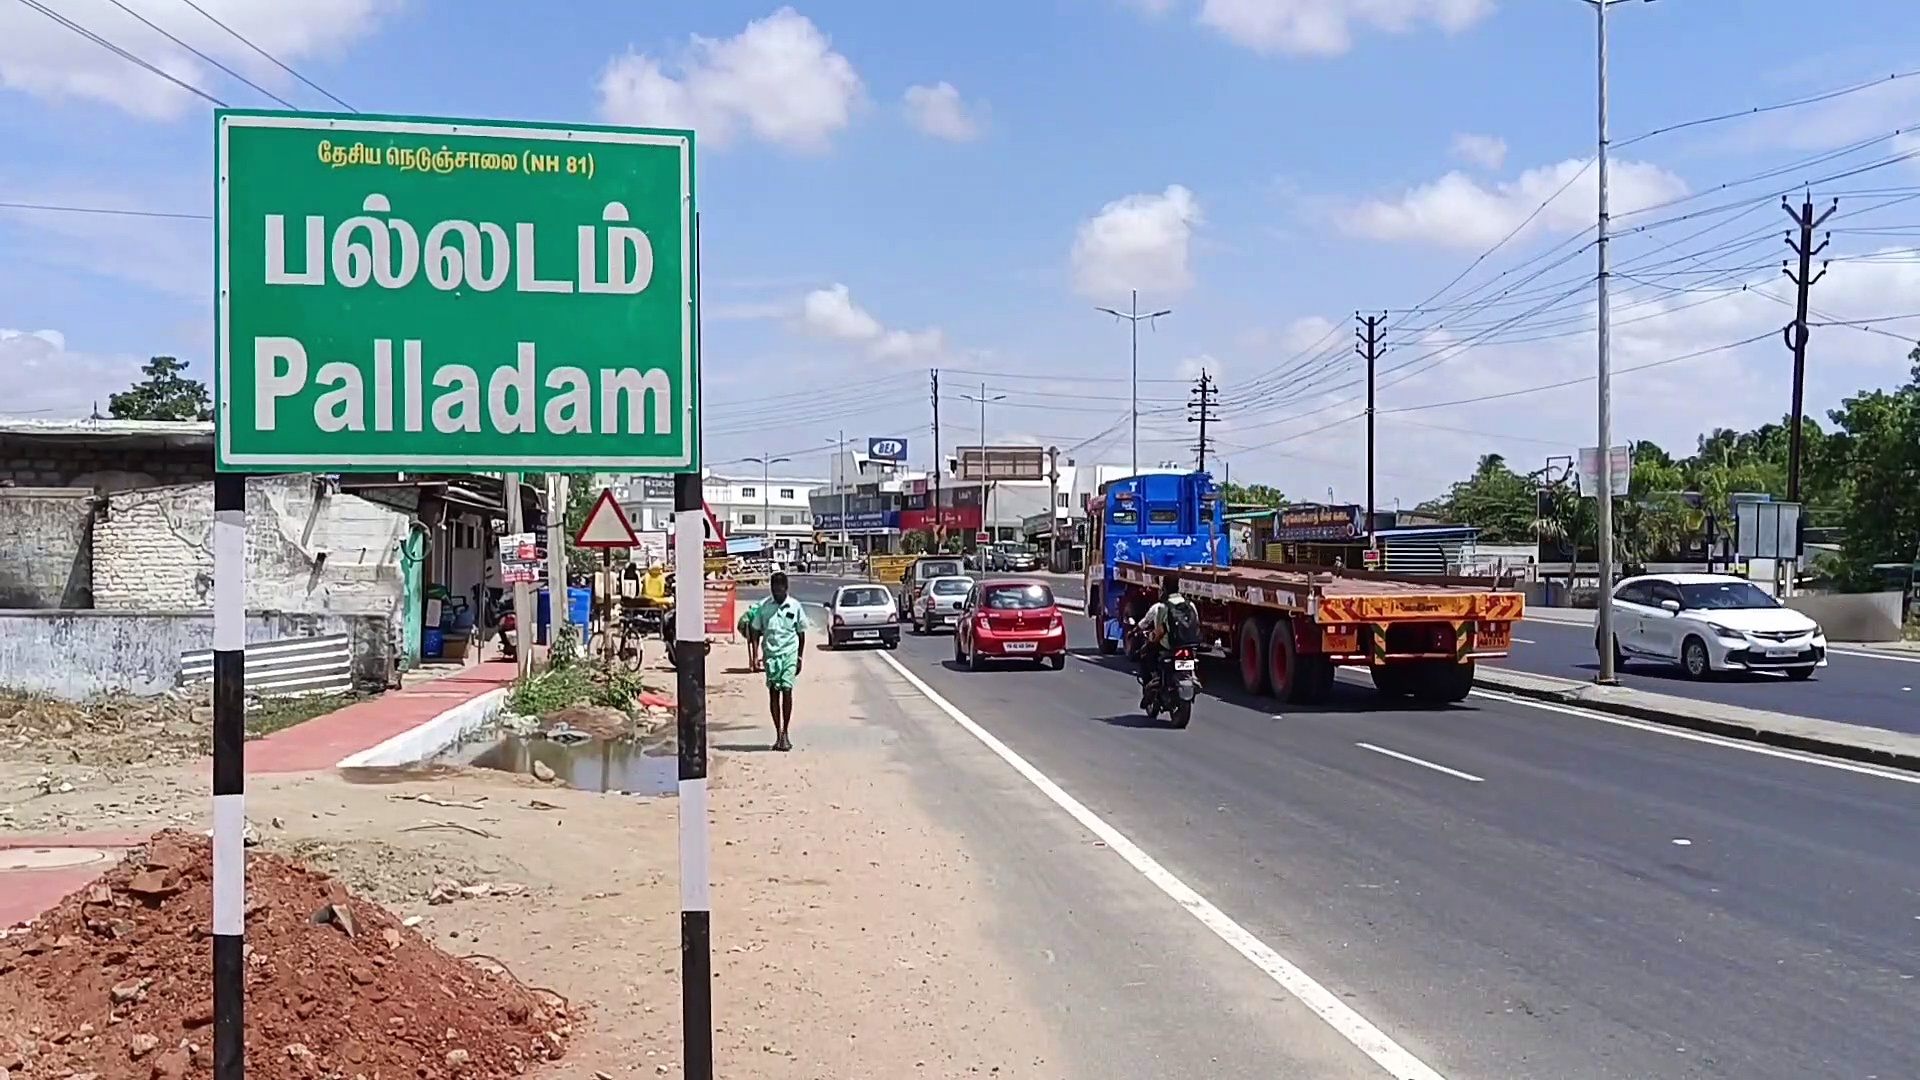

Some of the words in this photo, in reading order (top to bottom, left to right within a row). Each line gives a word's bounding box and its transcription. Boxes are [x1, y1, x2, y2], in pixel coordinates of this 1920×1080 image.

[318, 140, 381, 168] தேசிய
[386, 145, 517, 174] நெடுஞ்சாலை
[523, 150, 559, 174] (NH
[566, 153, 594, 179] 81)
[265, 193, 654, 295] பல்லடம்
[254, 336, 671, 434] Palladam
